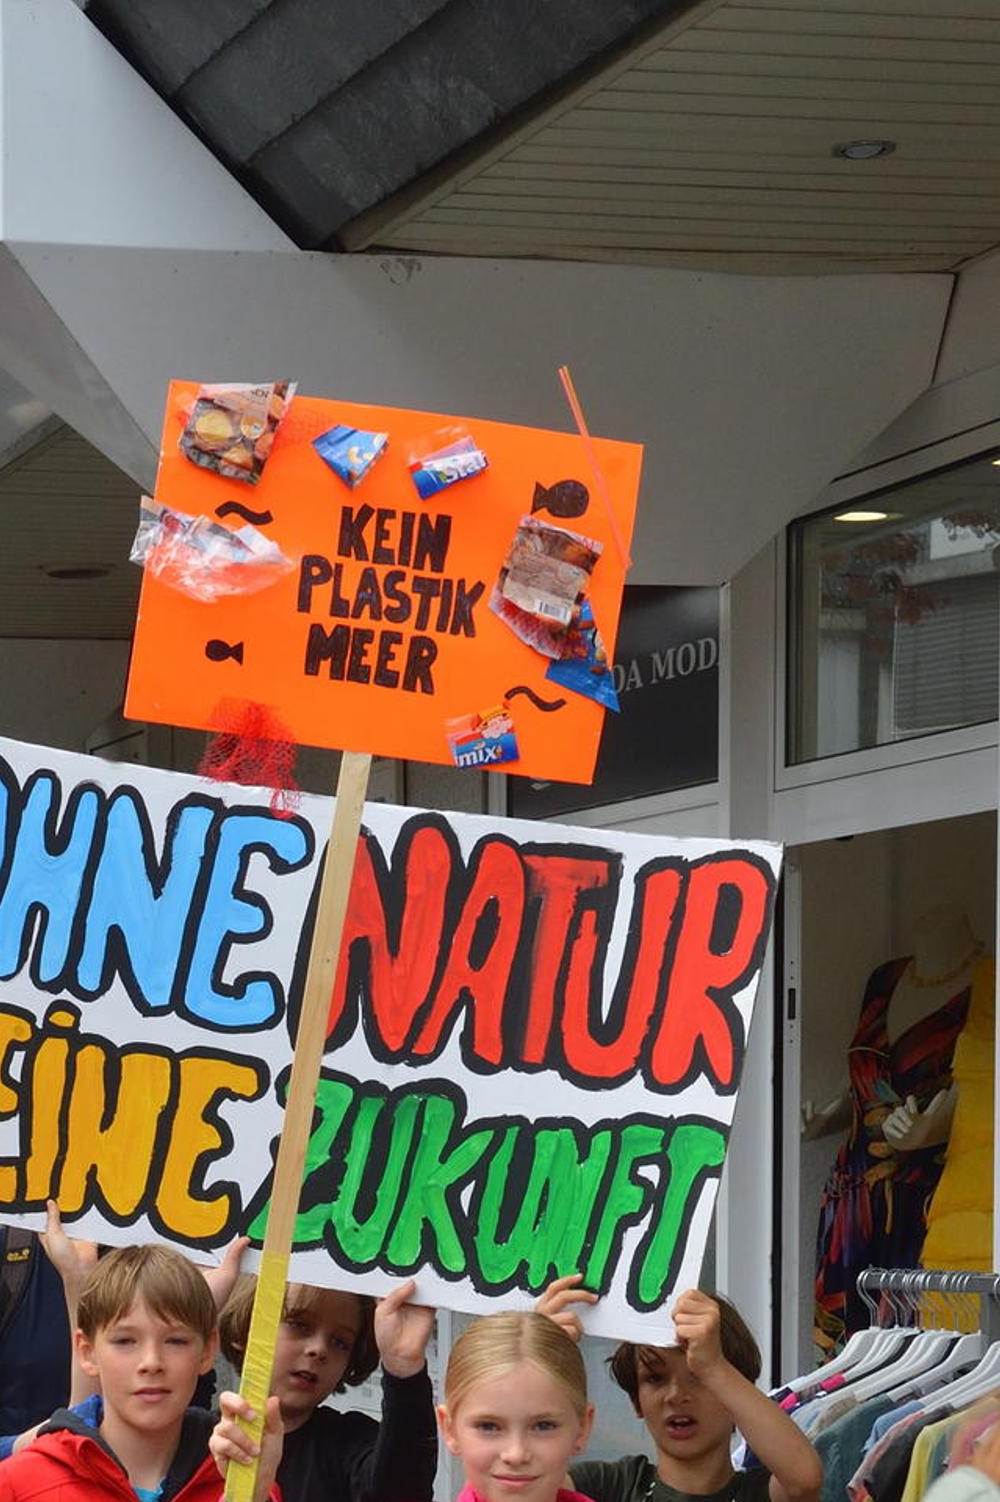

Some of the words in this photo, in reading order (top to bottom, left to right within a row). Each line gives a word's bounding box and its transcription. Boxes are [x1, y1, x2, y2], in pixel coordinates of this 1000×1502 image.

[337, 503, 452, 573] KEIN
[297, 554, 486, 638] PLASTIK
[304, 623, 438, 695] MEER
[650, 637, 719, 684] MOD
[286, 812, 777, 1096] NATUR
[240, 1068, 732, 1311] ZUKUNFT
